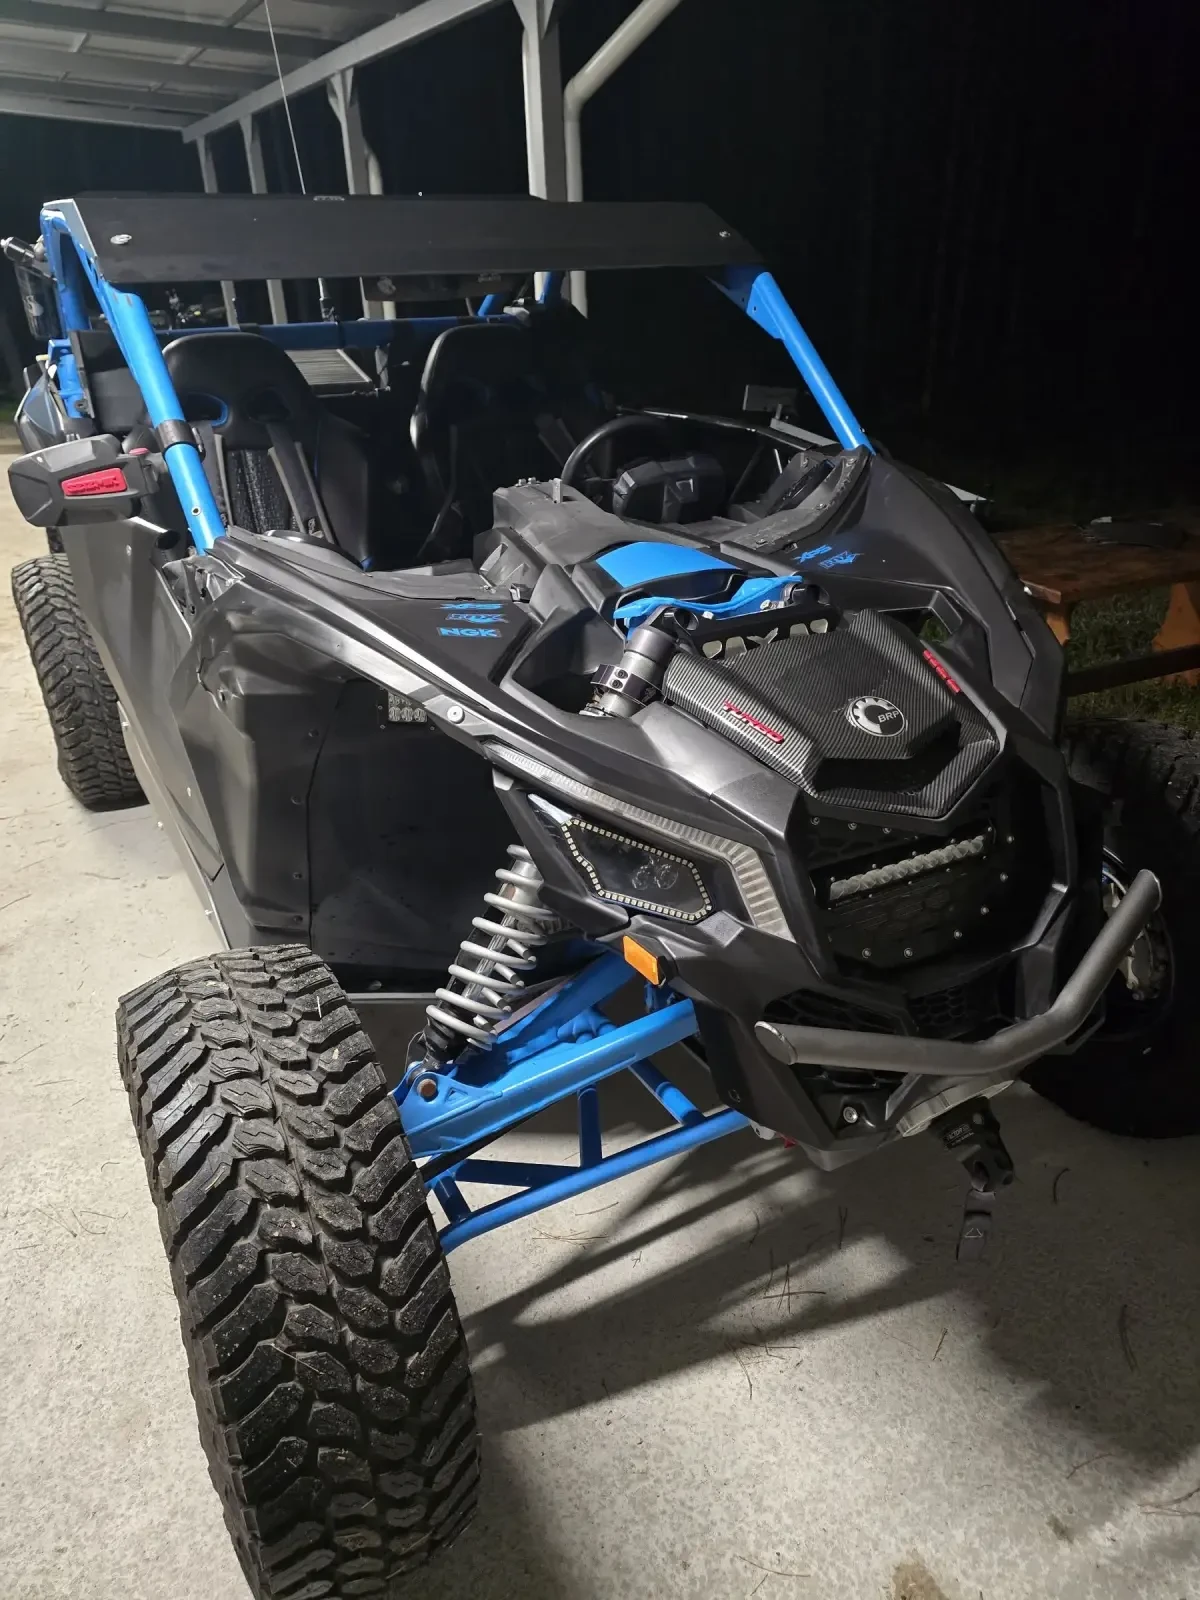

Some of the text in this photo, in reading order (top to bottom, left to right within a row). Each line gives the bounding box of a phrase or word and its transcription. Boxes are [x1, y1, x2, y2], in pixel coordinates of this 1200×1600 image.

[440, 628, 498, 637] NGK
[723, 699, 784, 743] TURBO
[878, 710, 900, 723] BRP
